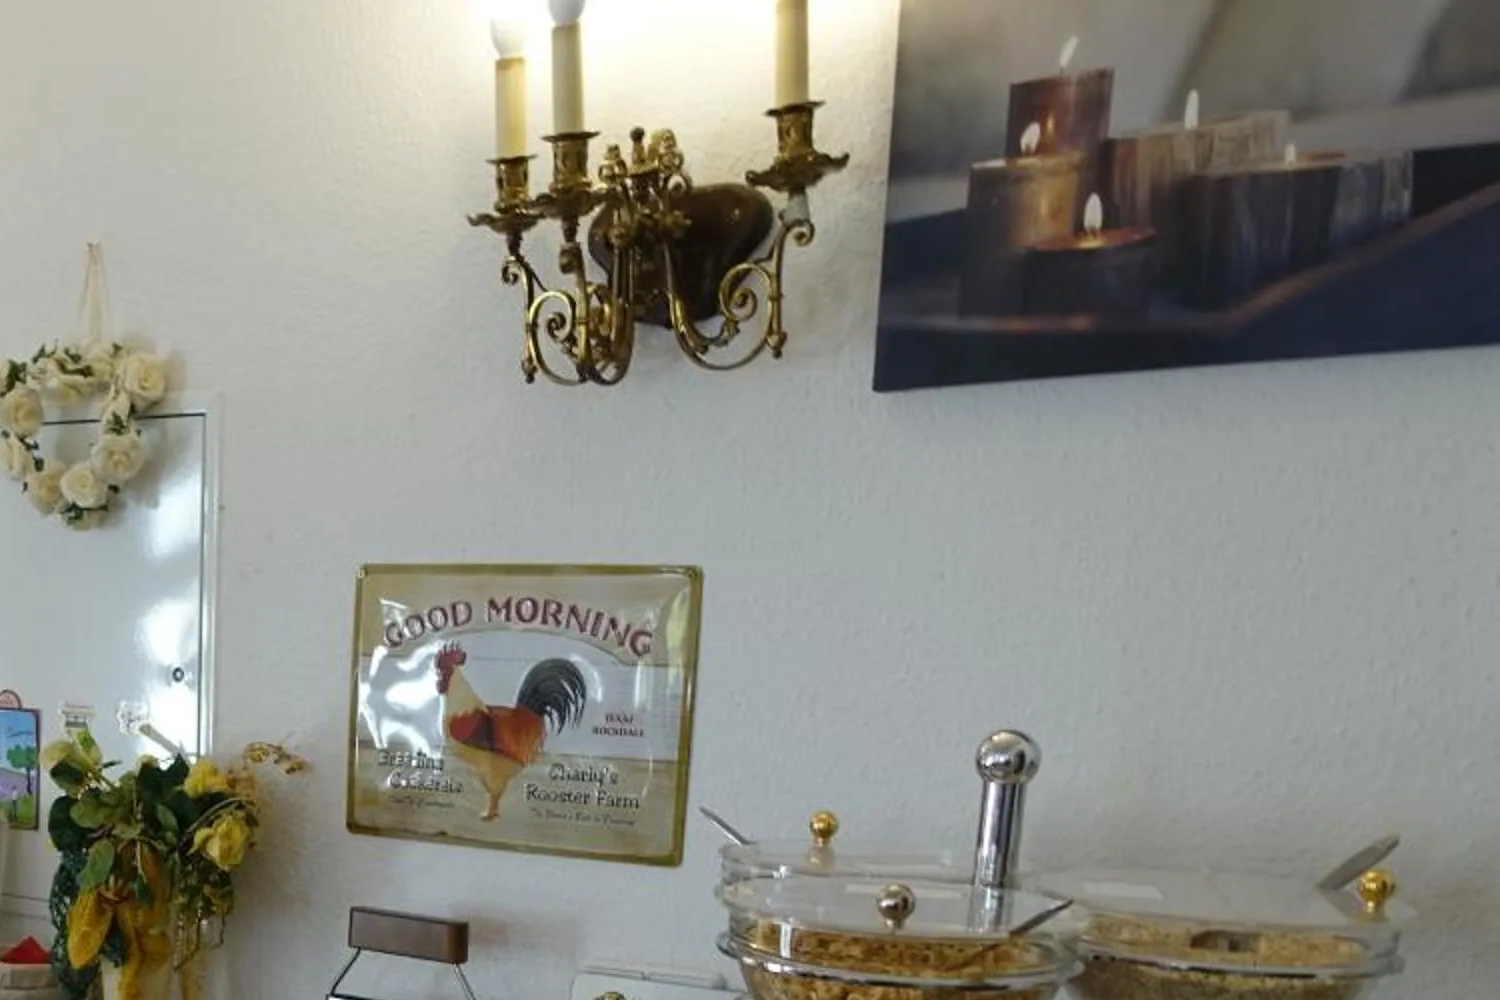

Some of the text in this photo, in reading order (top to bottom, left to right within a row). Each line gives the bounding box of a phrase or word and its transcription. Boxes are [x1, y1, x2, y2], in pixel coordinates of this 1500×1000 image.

[386, 596, 653, 657] GOOD MORNING
[525, 783, 639, 809] Rooster Farm
